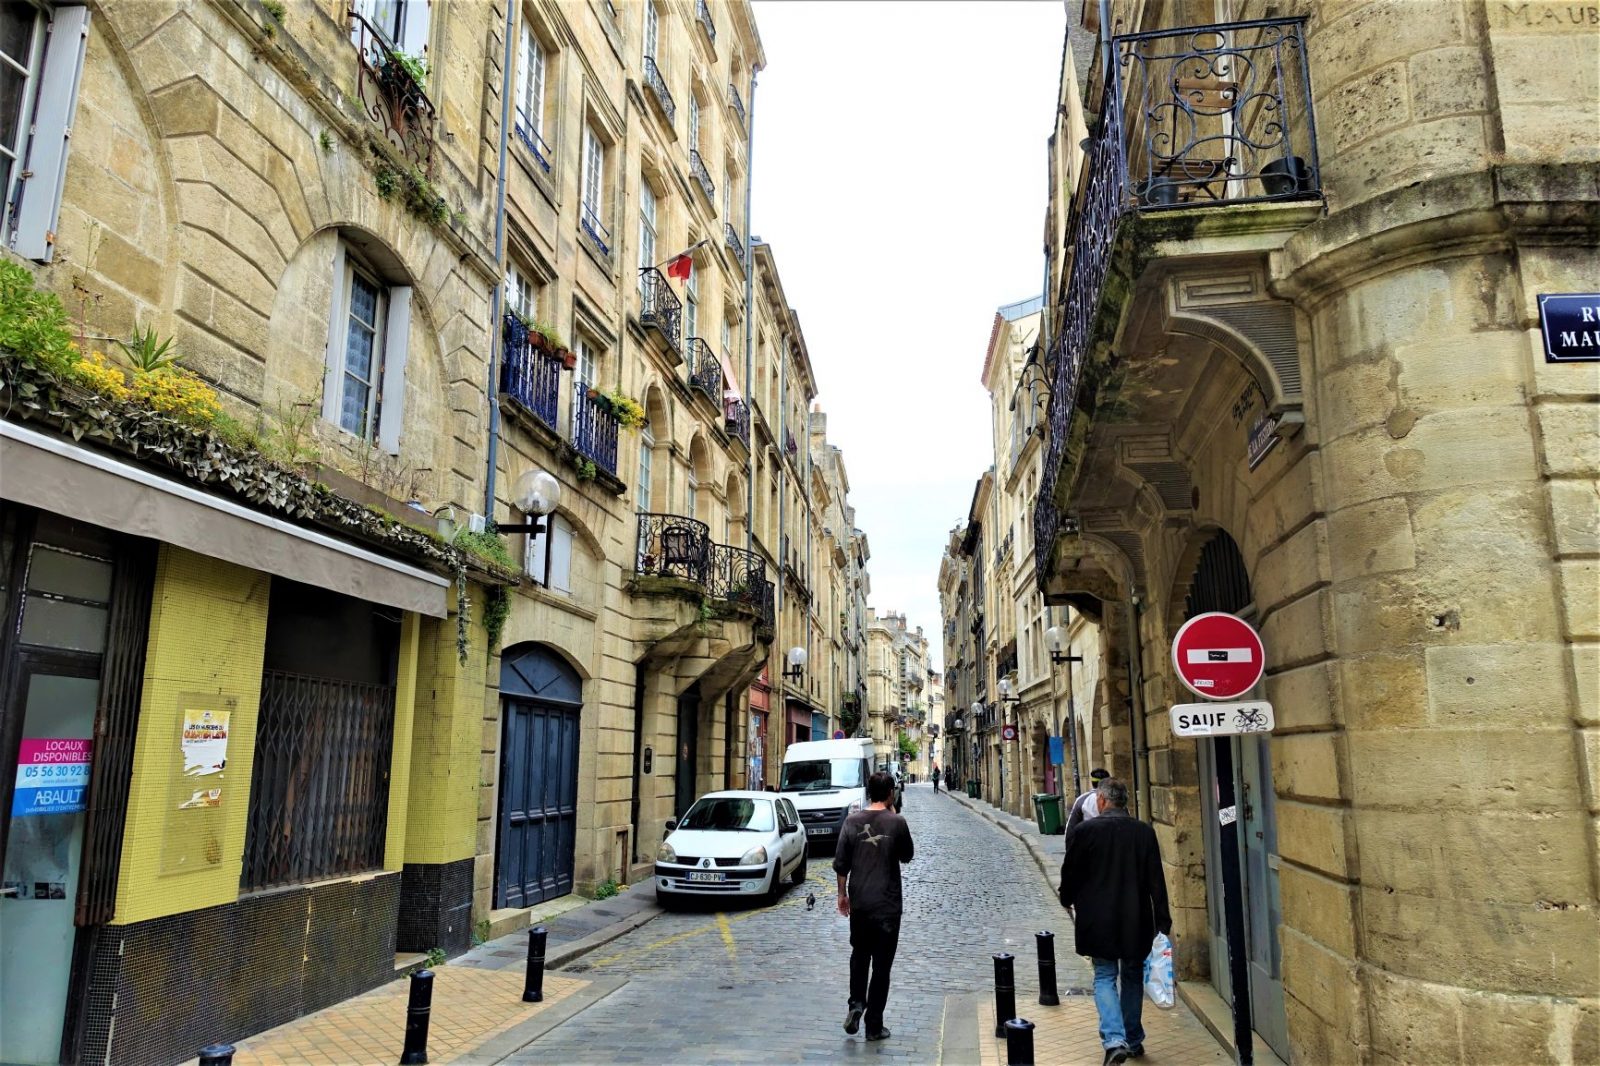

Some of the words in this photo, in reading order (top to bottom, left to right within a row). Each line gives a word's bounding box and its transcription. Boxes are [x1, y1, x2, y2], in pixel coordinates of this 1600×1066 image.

[1178, 712, 1226, 729] SAUF
[45, 741, 83, 751] LOCAUX
[33, 752, 93, 762] DISPONIBLES
[25, 767, 38, 777] 05
[41, 766, 53, 777] 56
[56, 766, 69, 777] 30
[70, 765, 82, 776] 92
[33, 788, 83, 806] ABAULT
